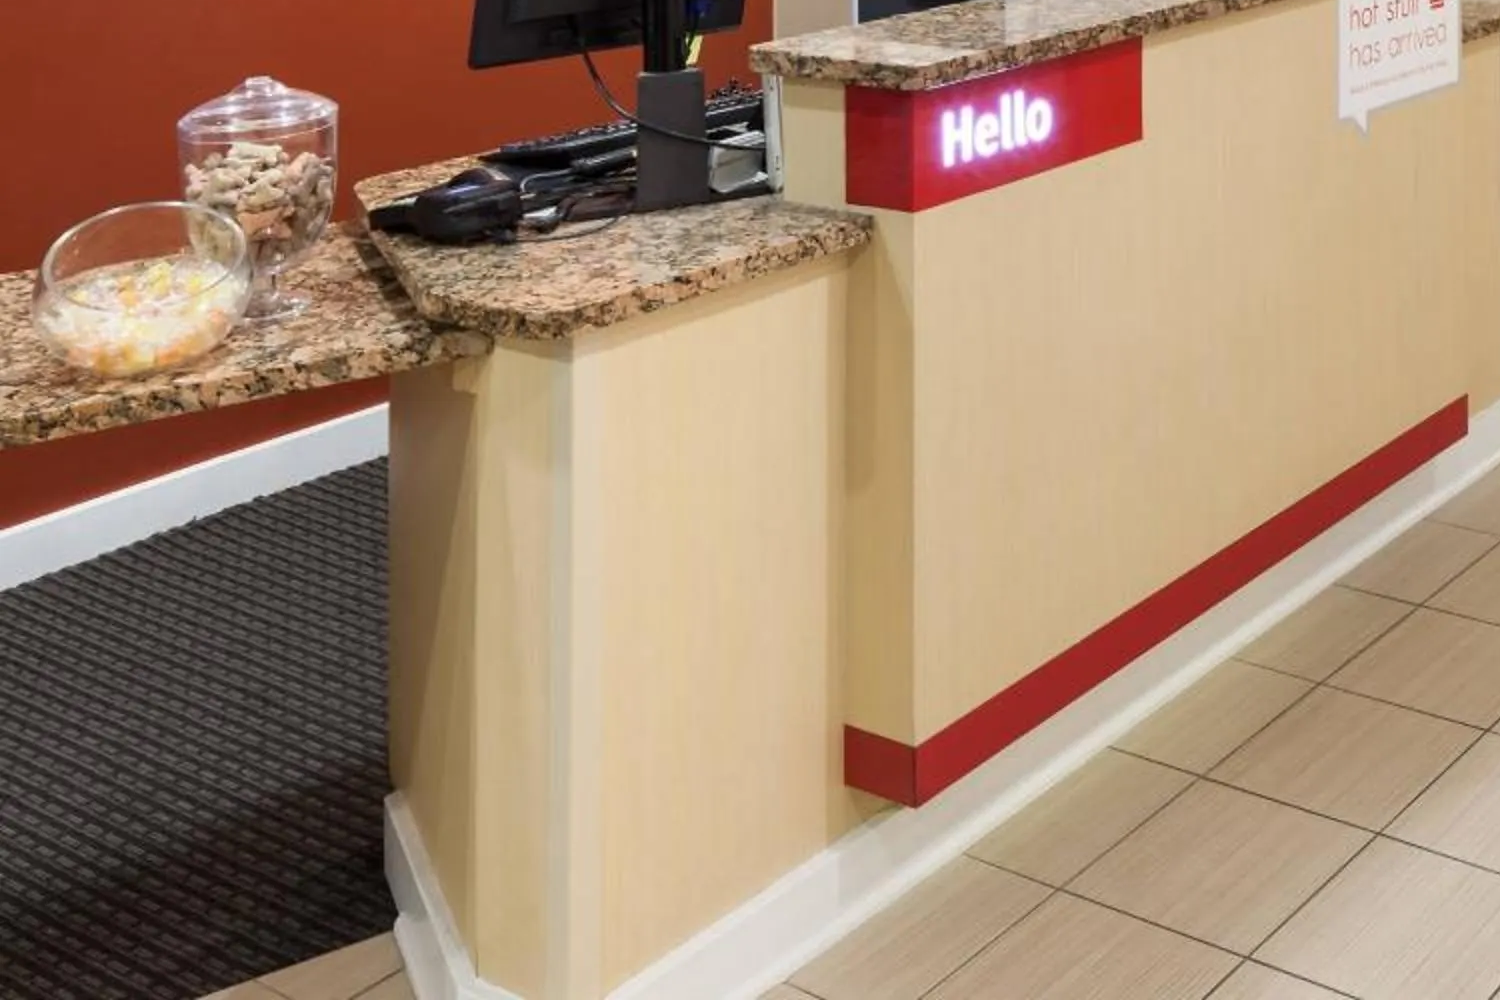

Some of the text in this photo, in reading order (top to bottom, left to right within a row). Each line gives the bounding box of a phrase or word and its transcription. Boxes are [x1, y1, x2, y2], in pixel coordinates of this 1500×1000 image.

[1348, 0, 1379, 31] hot
[1348, 40, 1382, 69] has
[940, 88, 1054, 168] Hello
